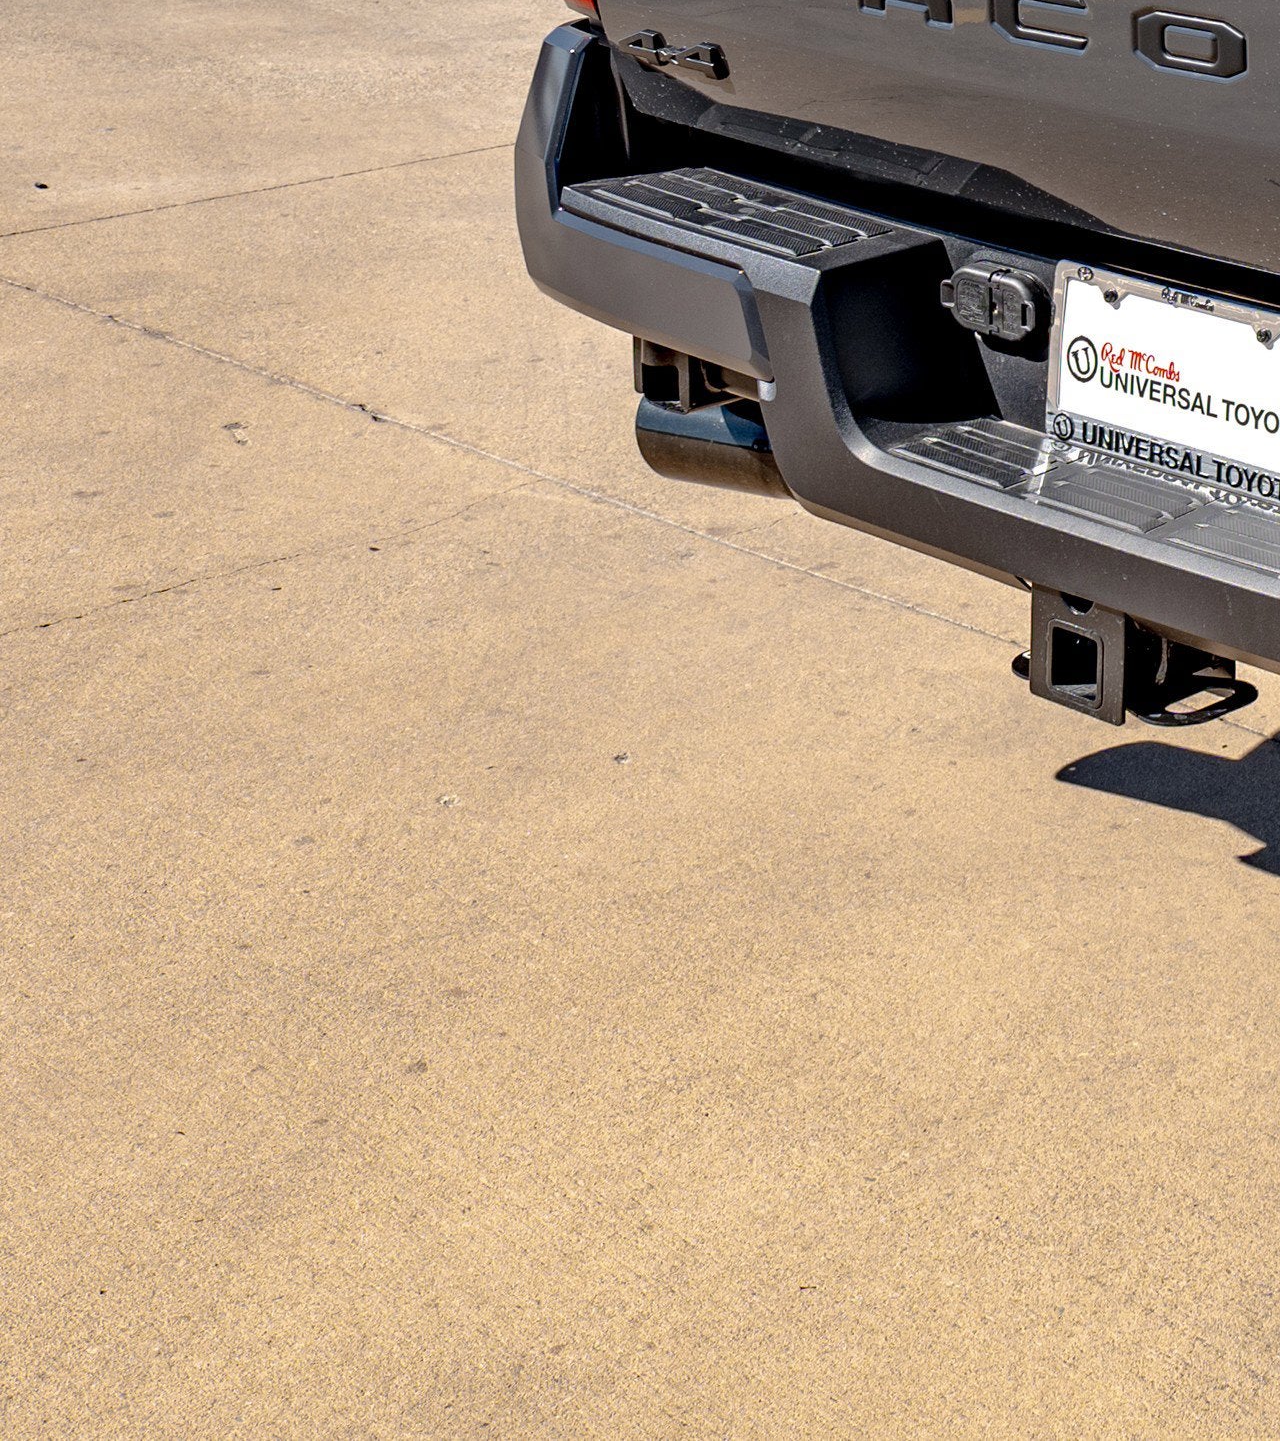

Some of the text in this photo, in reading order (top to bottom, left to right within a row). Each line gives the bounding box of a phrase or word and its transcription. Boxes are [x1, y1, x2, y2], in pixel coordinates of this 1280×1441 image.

[1100, 342, 1181, 382] Red McCombs
[1100, 366, 1218, 419] UNIVERSAL
[1082, 421, 1209, 479] UNIVERSAL
